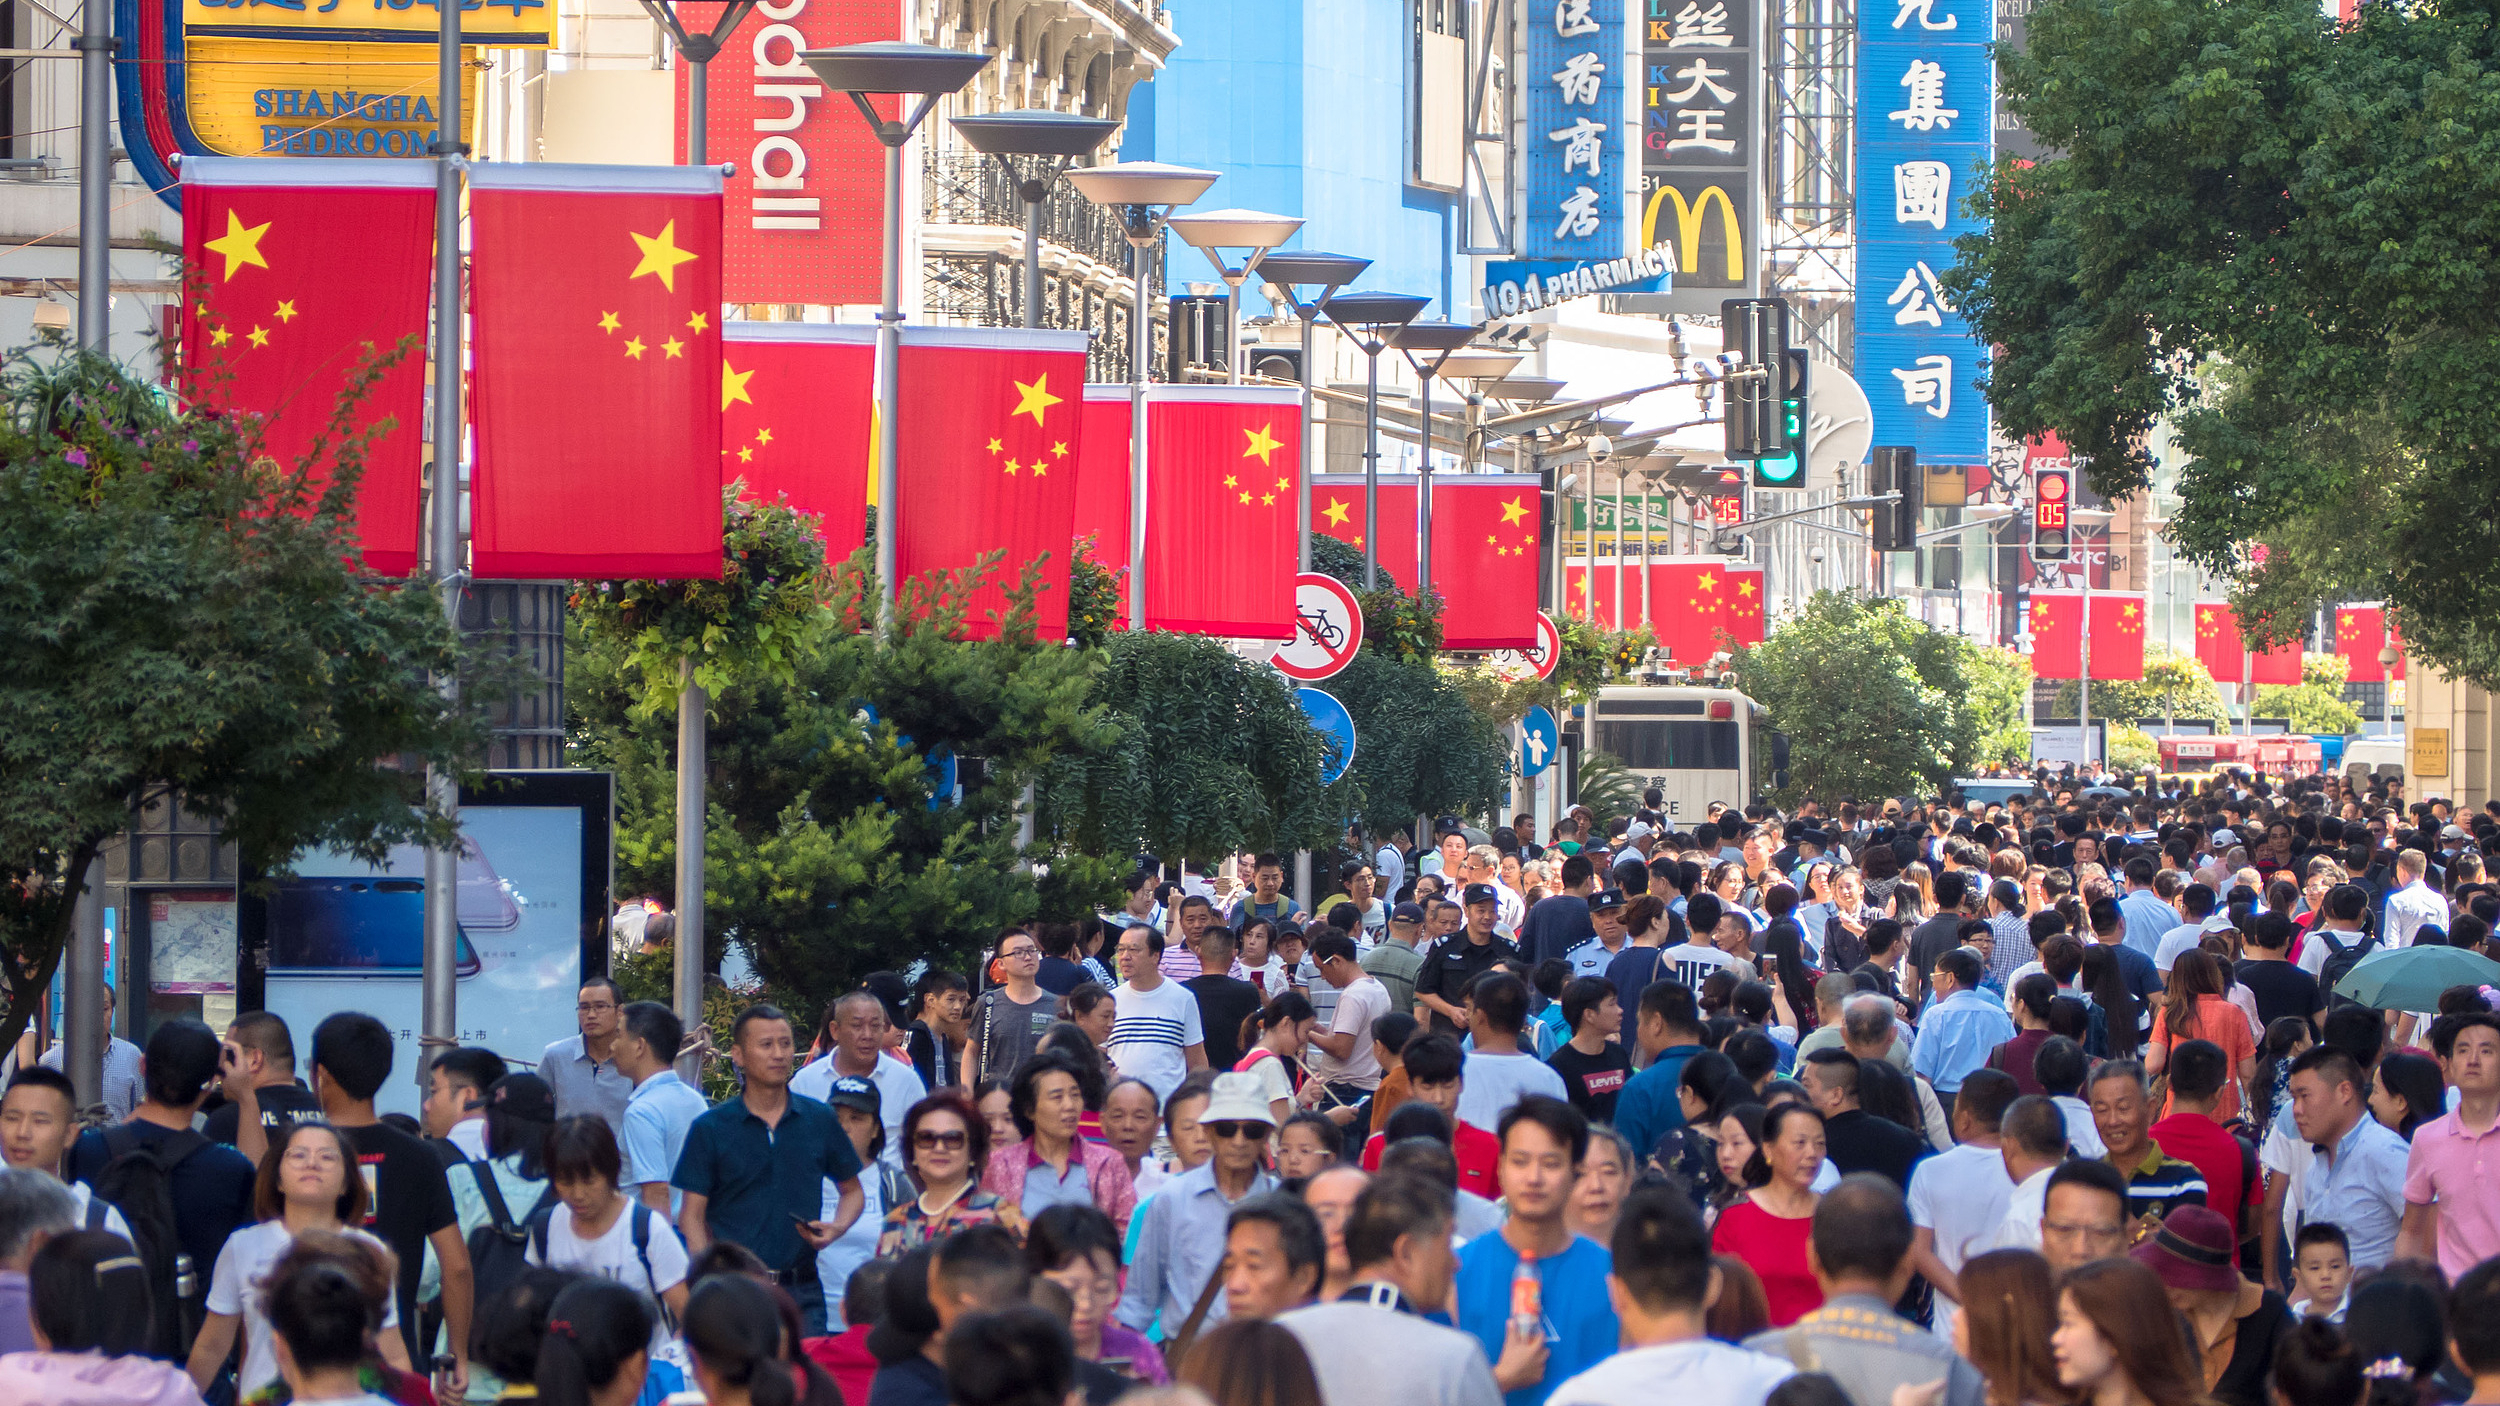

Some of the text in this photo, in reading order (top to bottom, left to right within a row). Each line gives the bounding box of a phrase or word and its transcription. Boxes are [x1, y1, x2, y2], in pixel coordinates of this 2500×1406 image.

[1666, 1, 1737, 153] 丝大王
[254, 89, 439, 122] SHANGHA
[1646, 65, 1671, 150] KING
[1546, 239, 1678, 298] PHARMACY
[2030, 457, 2069, 469] KFC
[2040, 503, 2065, 525] 05
[2111, 555, 2127, 571] B1
[460, 1029, 487, 1040] 上市
